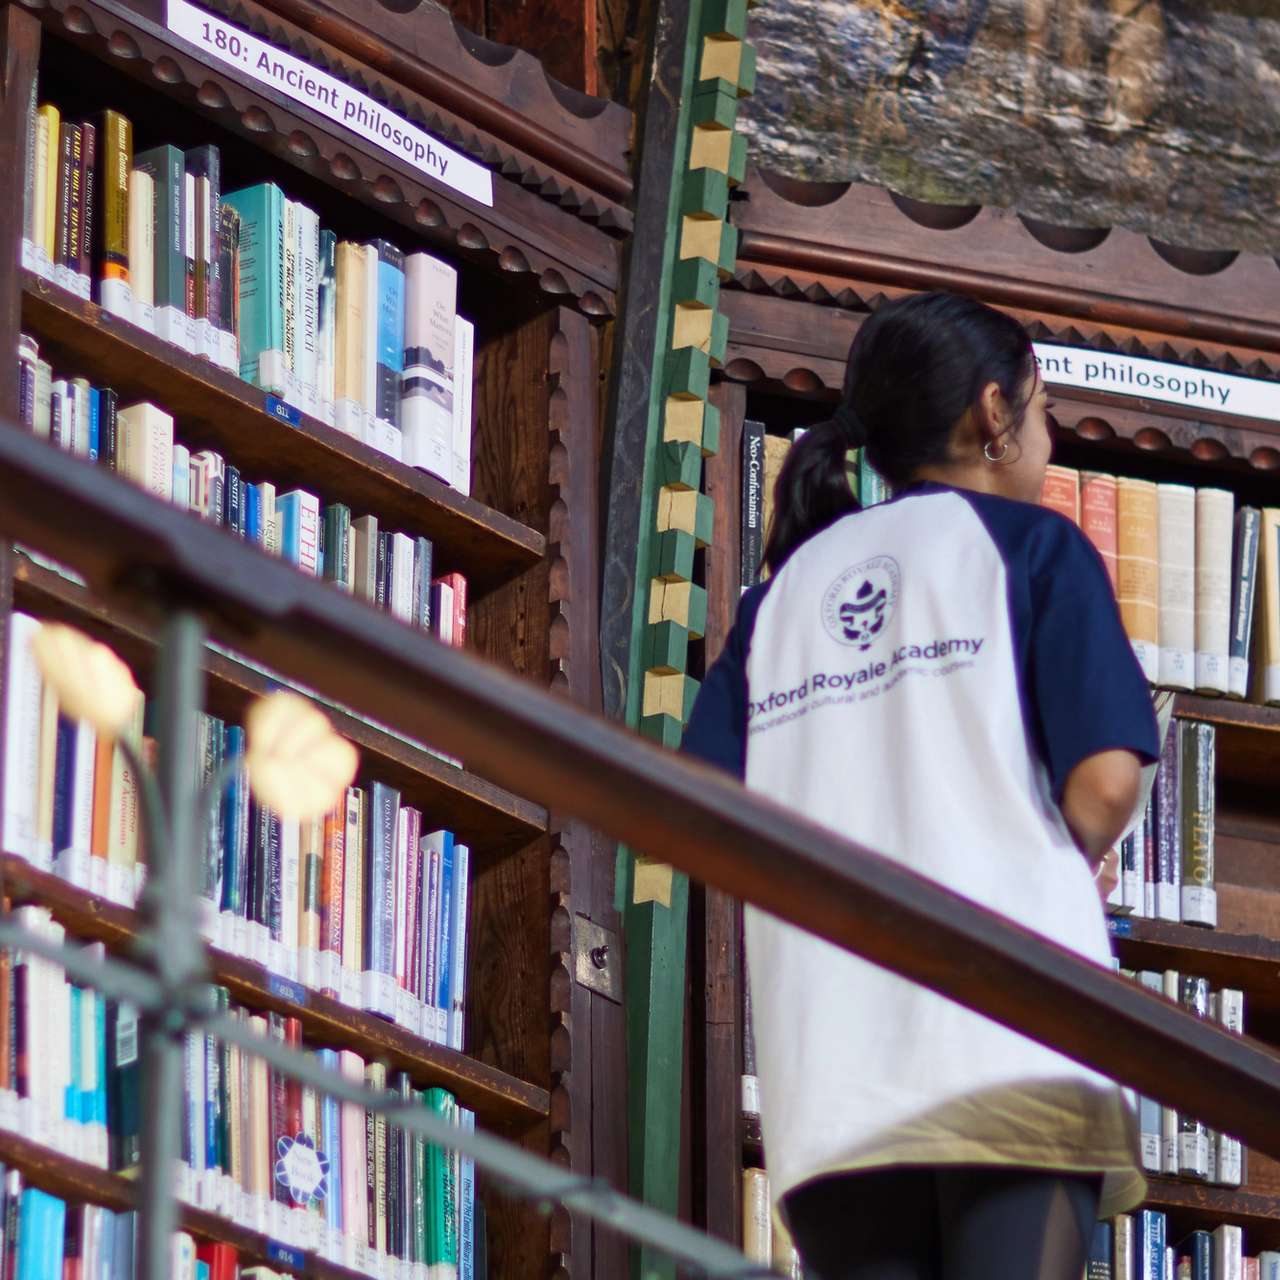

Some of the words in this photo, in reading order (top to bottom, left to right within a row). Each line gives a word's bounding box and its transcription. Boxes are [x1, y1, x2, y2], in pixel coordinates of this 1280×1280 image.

[201, 21, 250, 62] 180:
[257, 50, 340, 110] Ancient
[342, 99, 450, 177] philosophy
[118, 118, 128, 150] Human
[118, 152, 128, 192] Conduct
[304, 256, 314, 284] IRIS
[304, 285, 314, 354] MURDOCH
[1084, 361, 1232, 405] philosophy
[748, 434, 764, 528] Neo-Confucianism
[300, 504, 316, 572] ETHI
[811, 660, 887, 693] Royale
[889, 637, 985, 672] Academy
[384, 798, 392, 830] SUSAN
[1192, 812, 1216, 886] PLATO
[384, 878, 394, 922] MORAL
